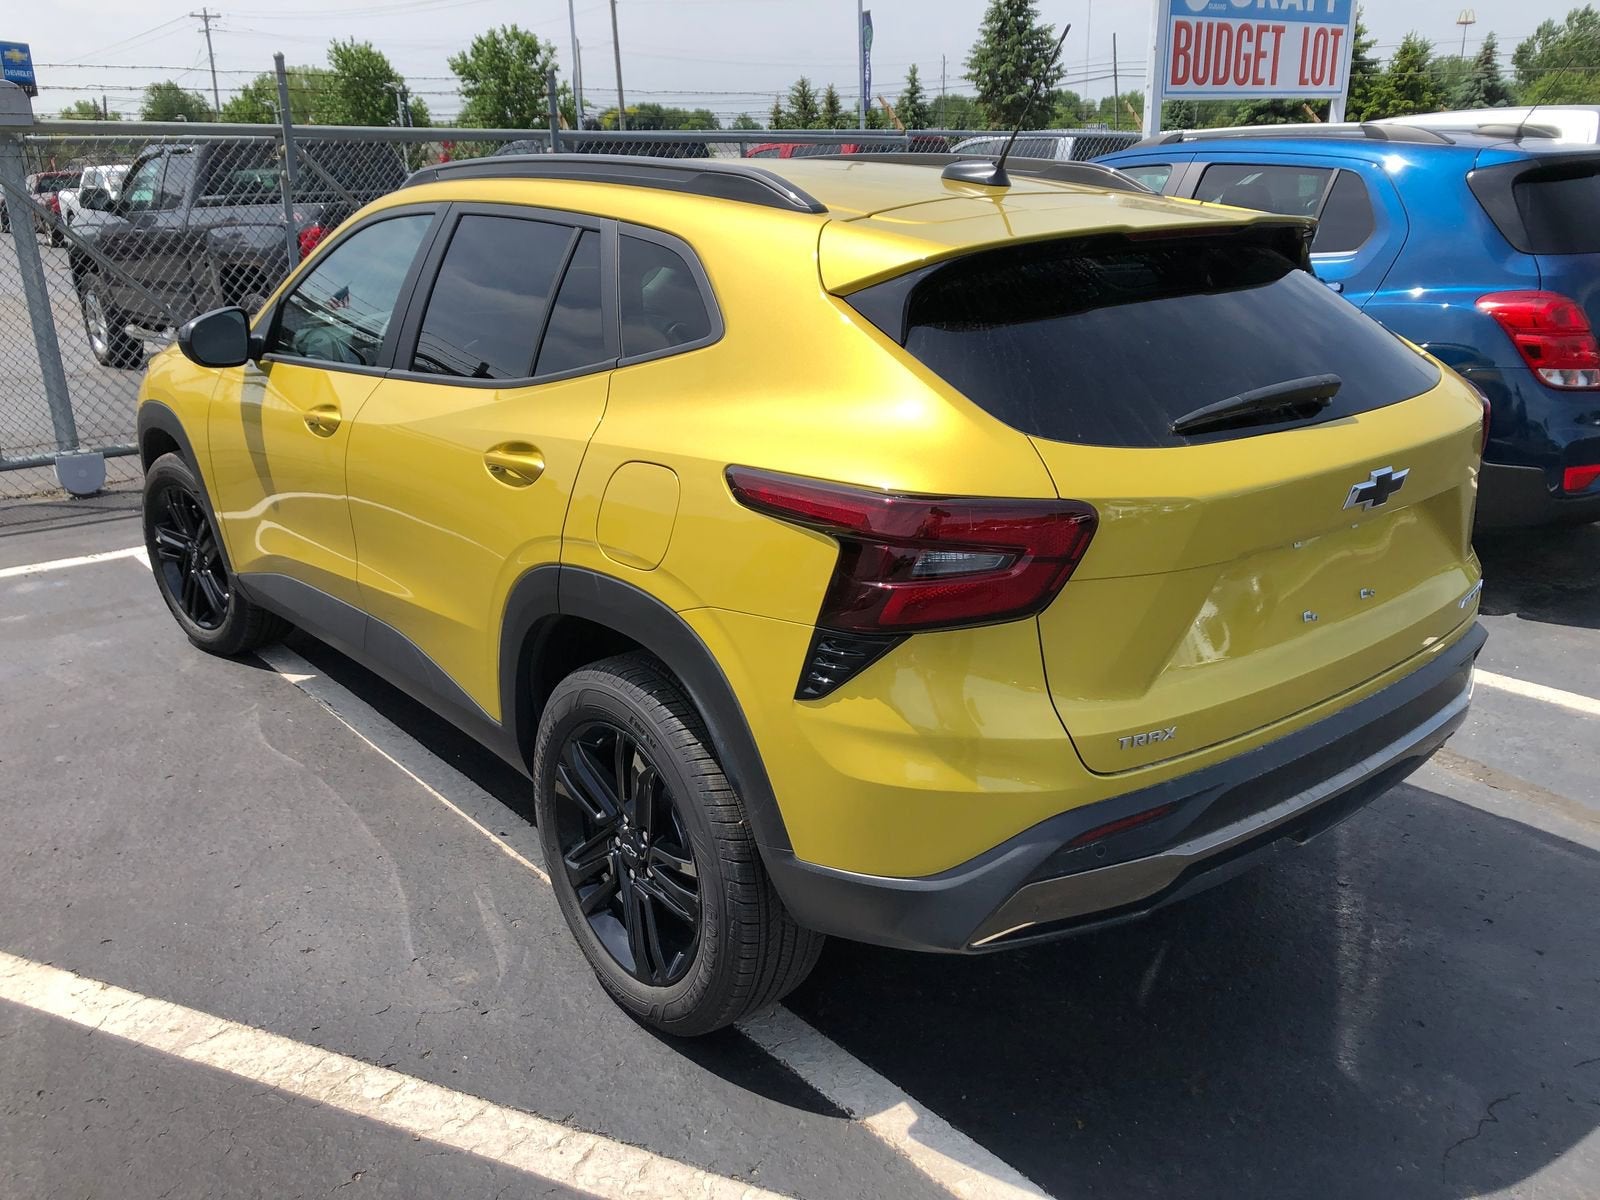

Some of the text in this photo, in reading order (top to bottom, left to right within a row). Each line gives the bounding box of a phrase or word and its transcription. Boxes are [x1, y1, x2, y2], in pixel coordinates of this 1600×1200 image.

[1170, 20, 1344, 86] BUDGET LOT
[1117, 726, 1177, 751] TRAX
